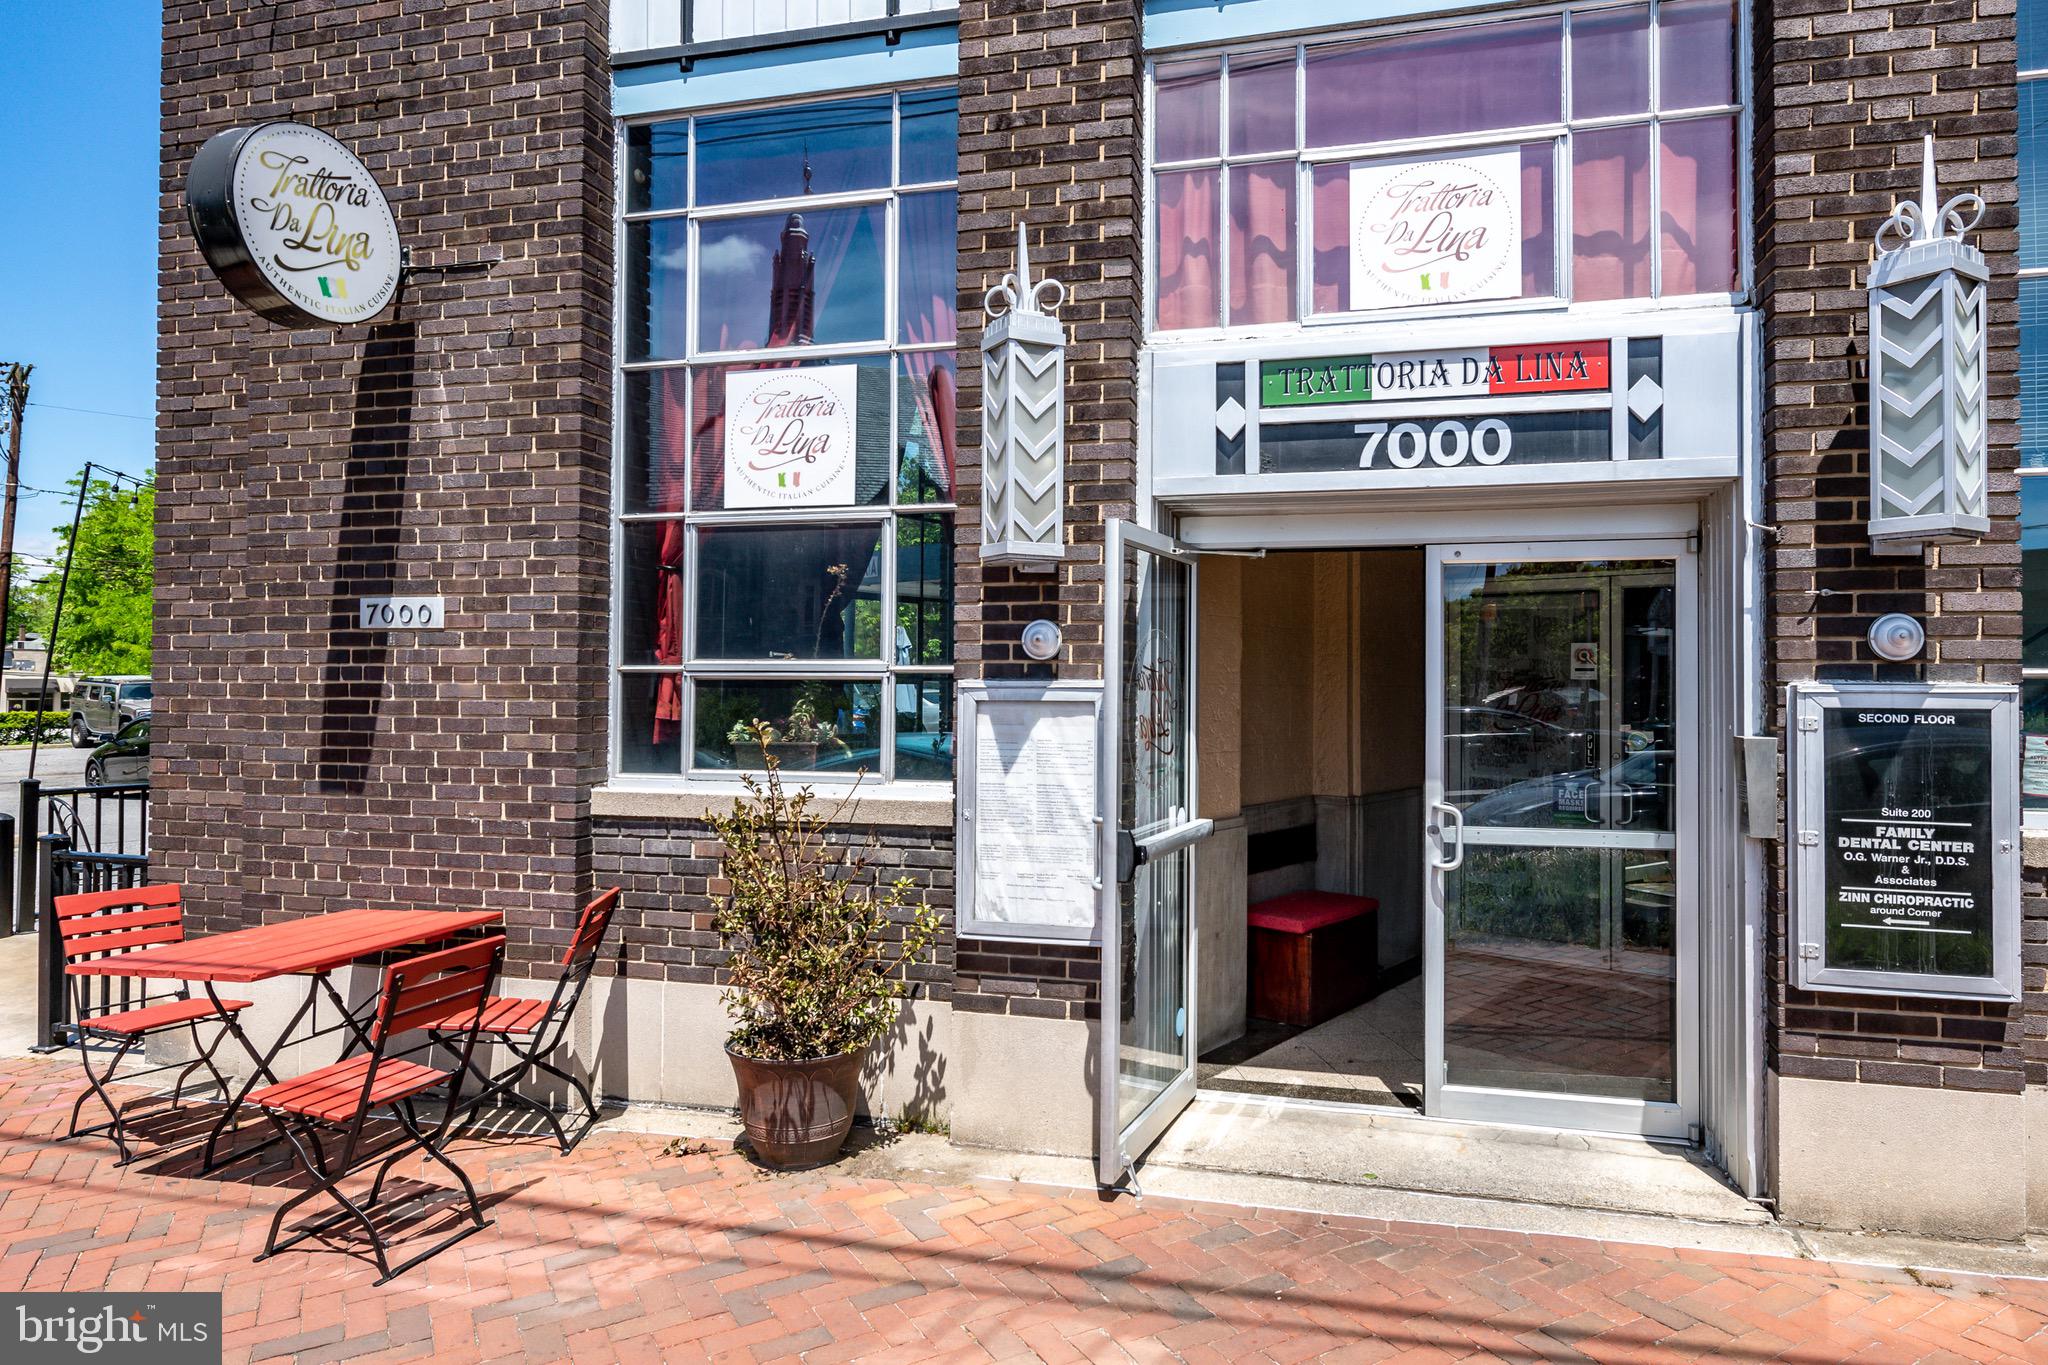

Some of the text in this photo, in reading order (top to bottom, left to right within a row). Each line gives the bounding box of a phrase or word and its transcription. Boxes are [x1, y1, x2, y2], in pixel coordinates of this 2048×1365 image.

[260, 151, 371, 207] Trattoria
[1386, 180, 1493, 220] Trattoria
[251, 198, 374, 271] Da Lina
[1370, 211, 1489, 272] Da Lina
[258, 256, 395, 315] AUTHENTIC ITALIAN CUISINE
[1278, 350, 1589, 397] TRATTORIA DA LINA
[753, 390, 836, 424] Trattoria
[740, 418, 831, 470] Da Lina
[1354, 418, 1512, 468] 7000
[736, 465, 777, 498] AUTHENTIC
[366, 604, 432, 625] 7000
[1858, 713, 1955, 724] SECOND FLOOR
[1558, 789, 1585, 799] FACE
[1881, 807, 1931, 818] Suite 200
[1876, 826, 1936, 839] FAMILY
[1838, 837, 1974, 853] DENTAL CENTER
[1843, 852, 1969, 866] O.G. Warner Jr., D.D.S.
[1874, 875, 1937, 887] Associates
[1901, 866, 1910, 875] &
[1839, 892, 1974, 908] ZINN CHIROPRACTIC
[1870, 907, 1942, 918] around Corner
